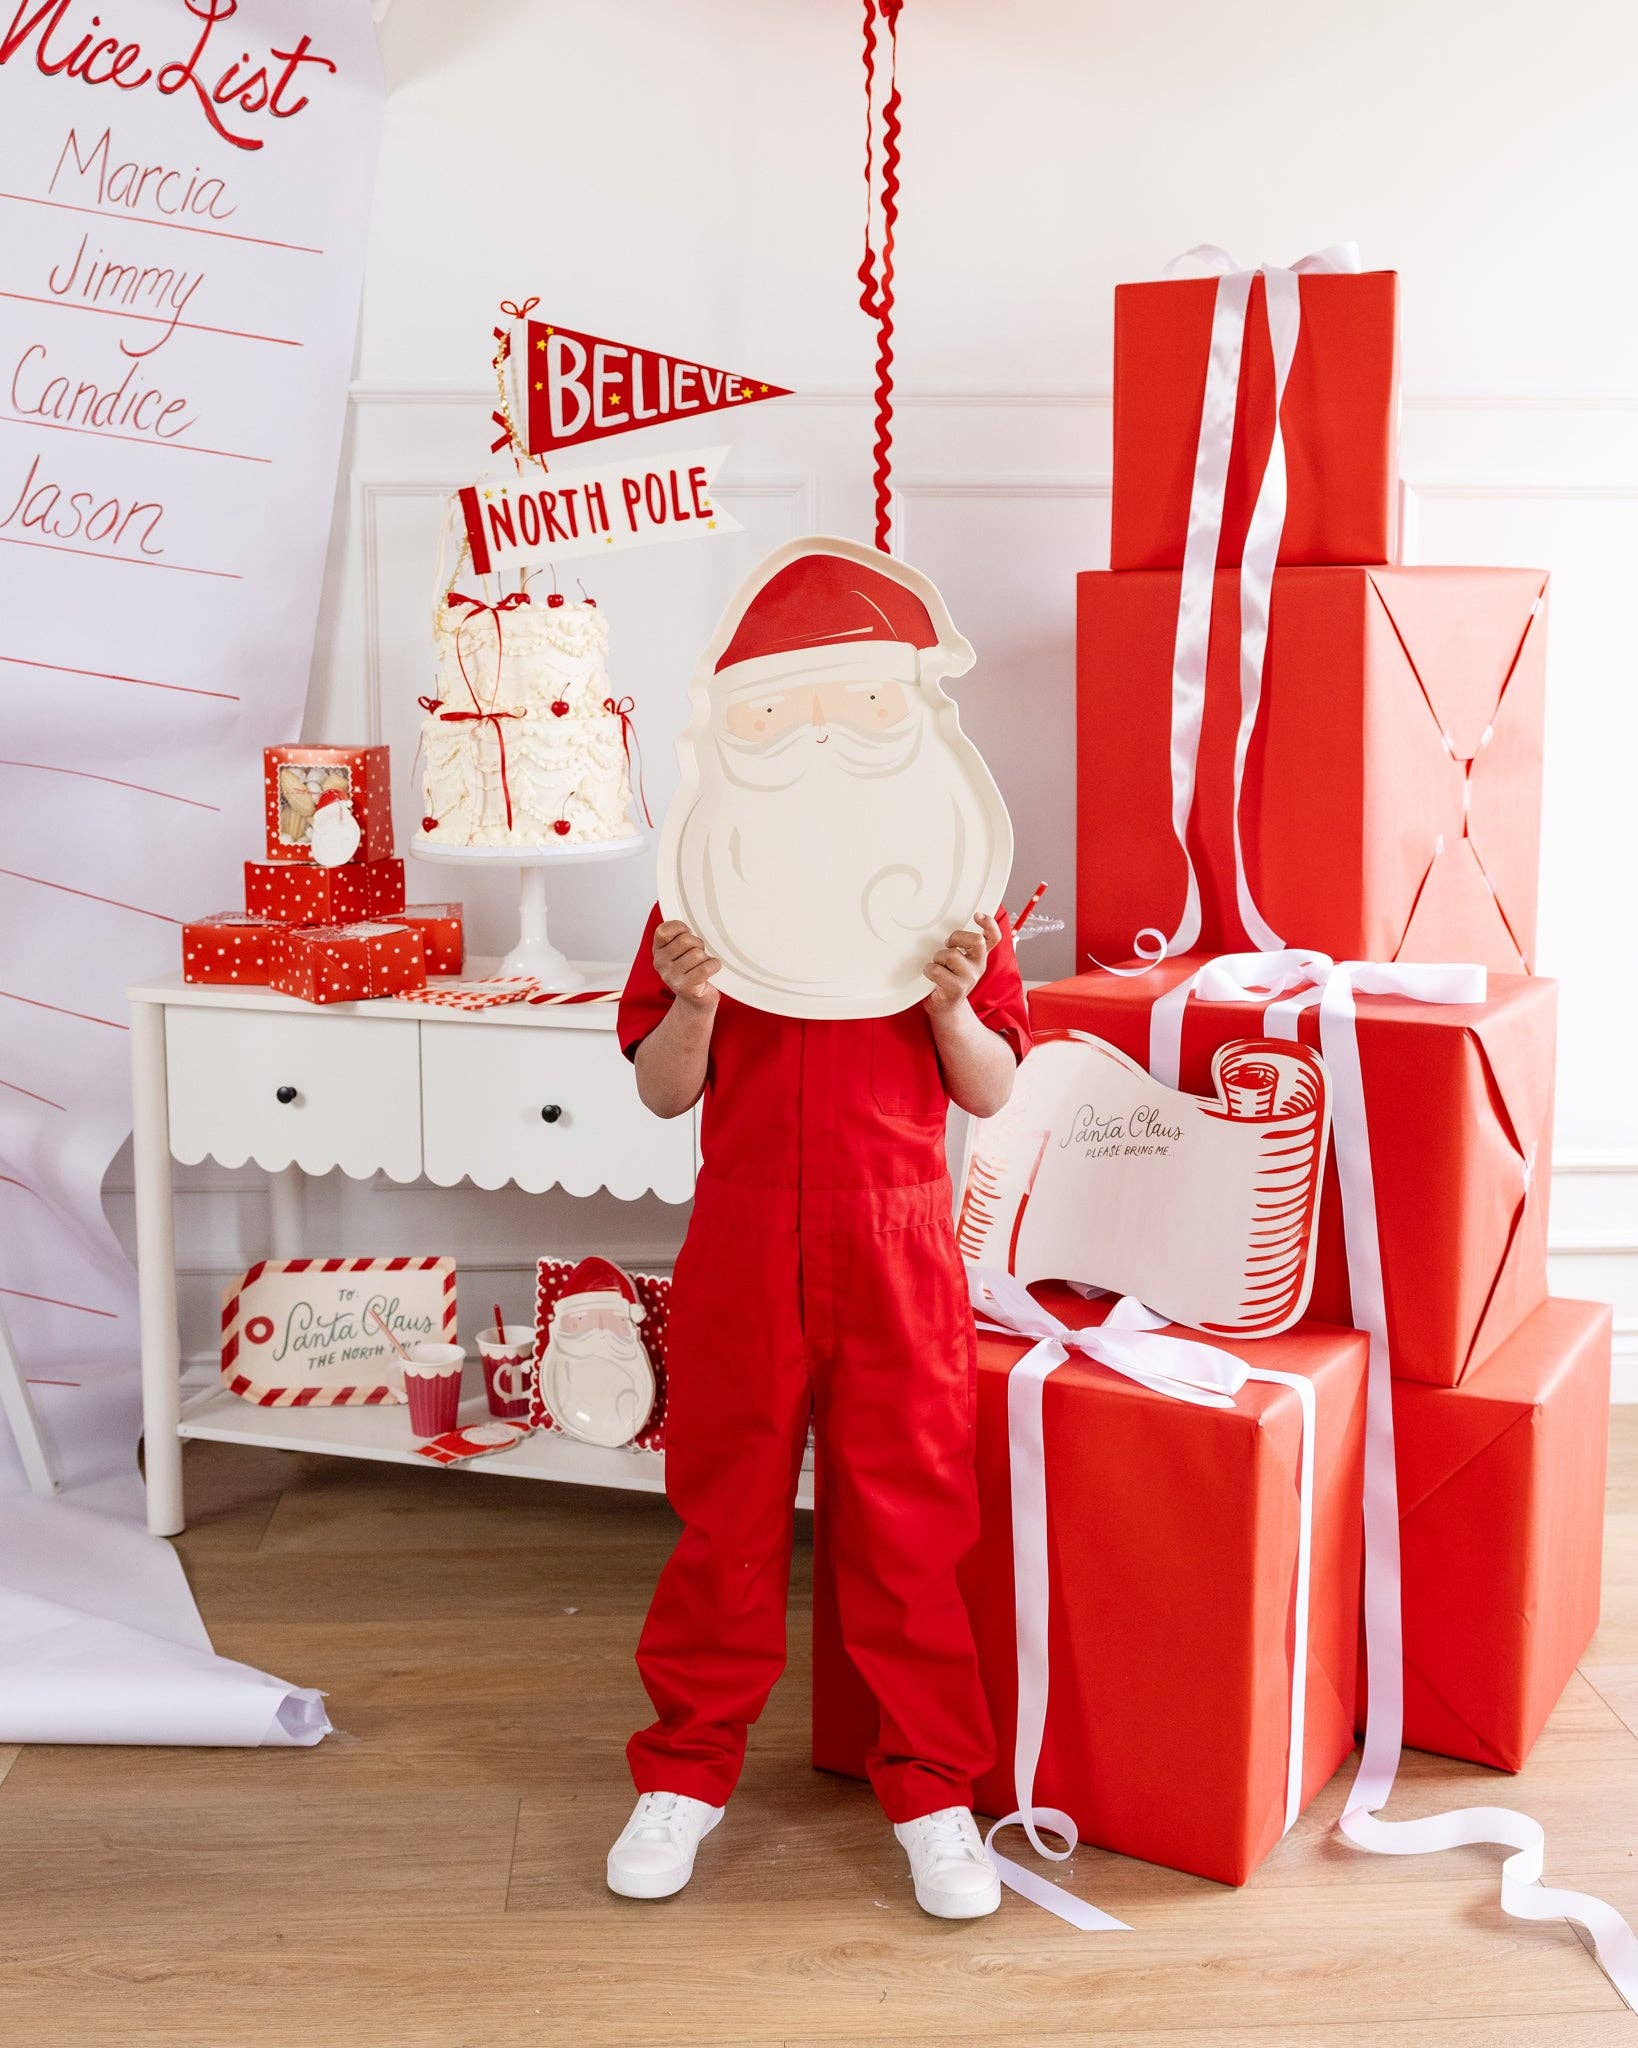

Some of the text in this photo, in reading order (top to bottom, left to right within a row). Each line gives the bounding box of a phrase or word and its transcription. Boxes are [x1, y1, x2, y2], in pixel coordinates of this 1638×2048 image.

[0, 0, 337, 150] Nice List
[49, 127, 239, 219] Marcia
[49, 232, 205, 358] Jimmy
[12, 344, 200, 438] Candice
[547, 334, 744, 438] BELIEVE
[0, 453, 165, 555] Jason
[487, 466, 714, 552] NORTH POLE
[1060, 1103, 1184, 1149] Santa Claus
[1085, 1144, 1122, 1158] PLEASE
[1124, 1145, 1154, 1157] BRING
[272, 1295, 437, 1361] Santa Claus
[307, 1353, 337, 1371] THE
[341, 1345, 385, 1363] NORTH
